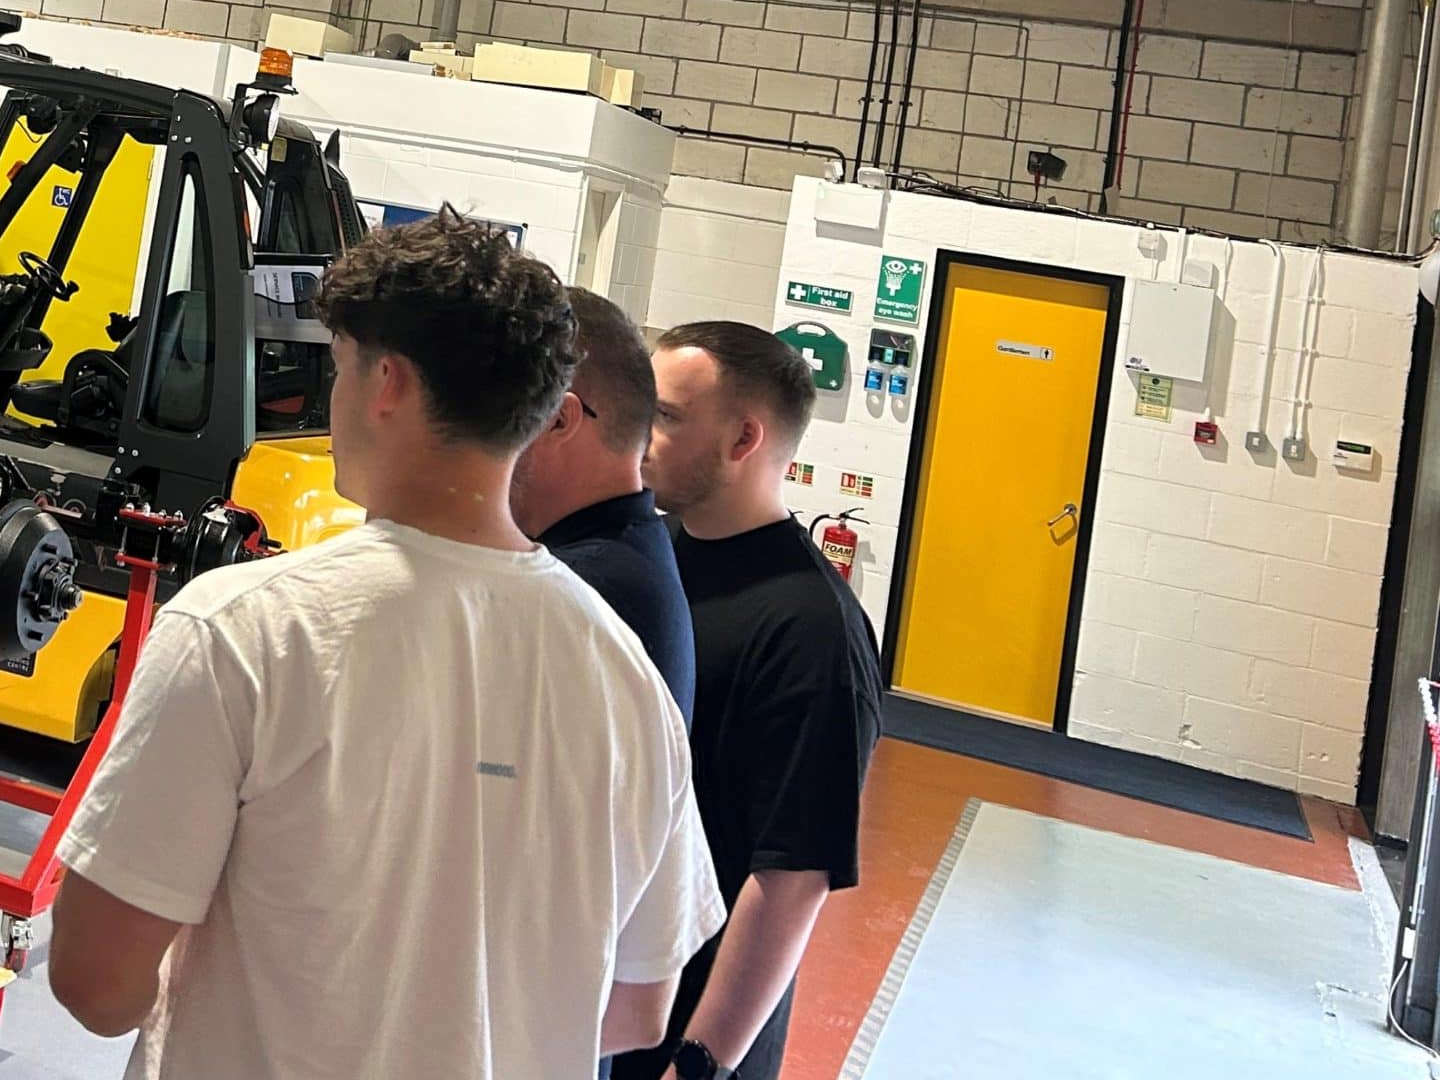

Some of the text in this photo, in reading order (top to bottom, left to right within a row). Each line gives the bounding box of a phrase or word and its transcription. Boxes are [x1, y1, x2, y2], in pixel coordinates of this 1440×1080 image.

[811, 285, 849, 299] First aid
[820, 296, 838, 307] box
[876, 297, 918, 312] Emergency
[878, 307, 913, 318] eye wash
[825, 543, 852, 555] FOAM
